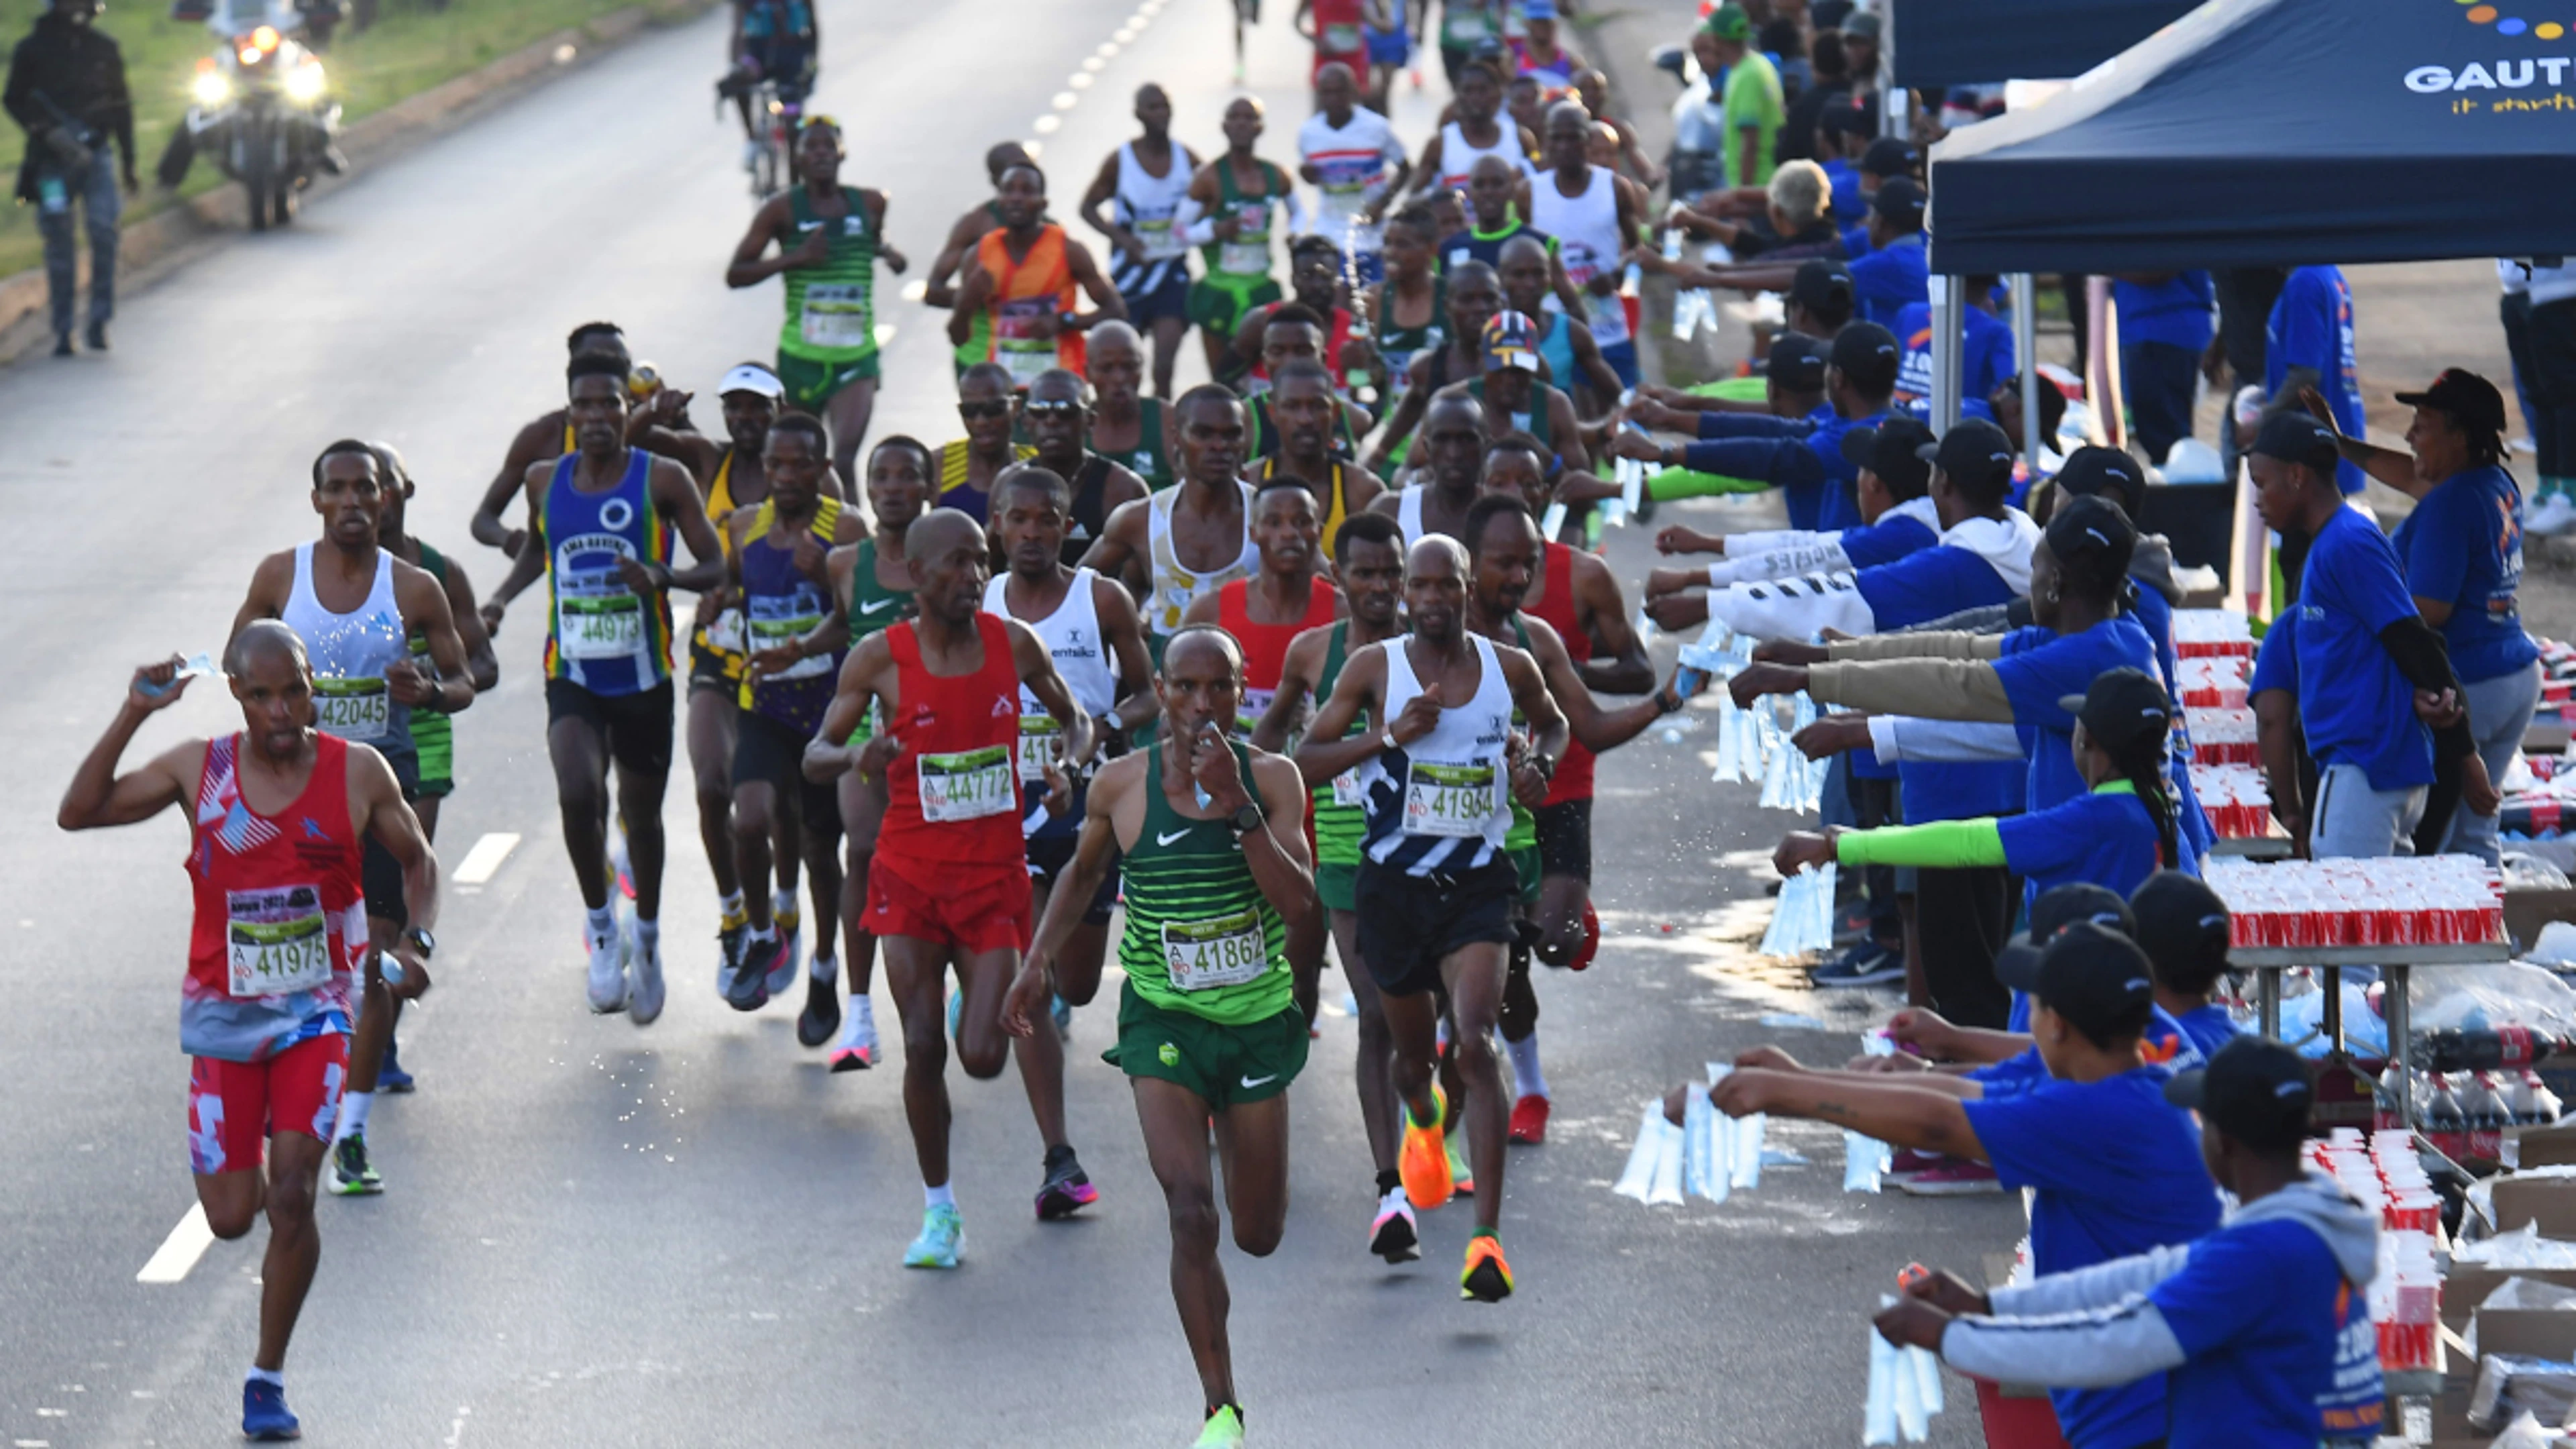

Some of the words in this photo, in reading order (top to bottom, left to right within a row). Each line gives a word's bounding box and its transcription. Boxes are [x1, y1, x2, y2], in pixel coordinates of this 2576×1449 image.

[2404, 56, 2576, 94] GAUT
[1051, 646, 1096, 658] entsika
[321, 696, 386, 725] 42045
[946, 767, 1010, 804] 44772
[1409, 785, 1423, 802] A
[256, 935, 327, 977] 41975
[1169, 945, 1183, 961] A
[1194, 930, 1263, 973] 41862
